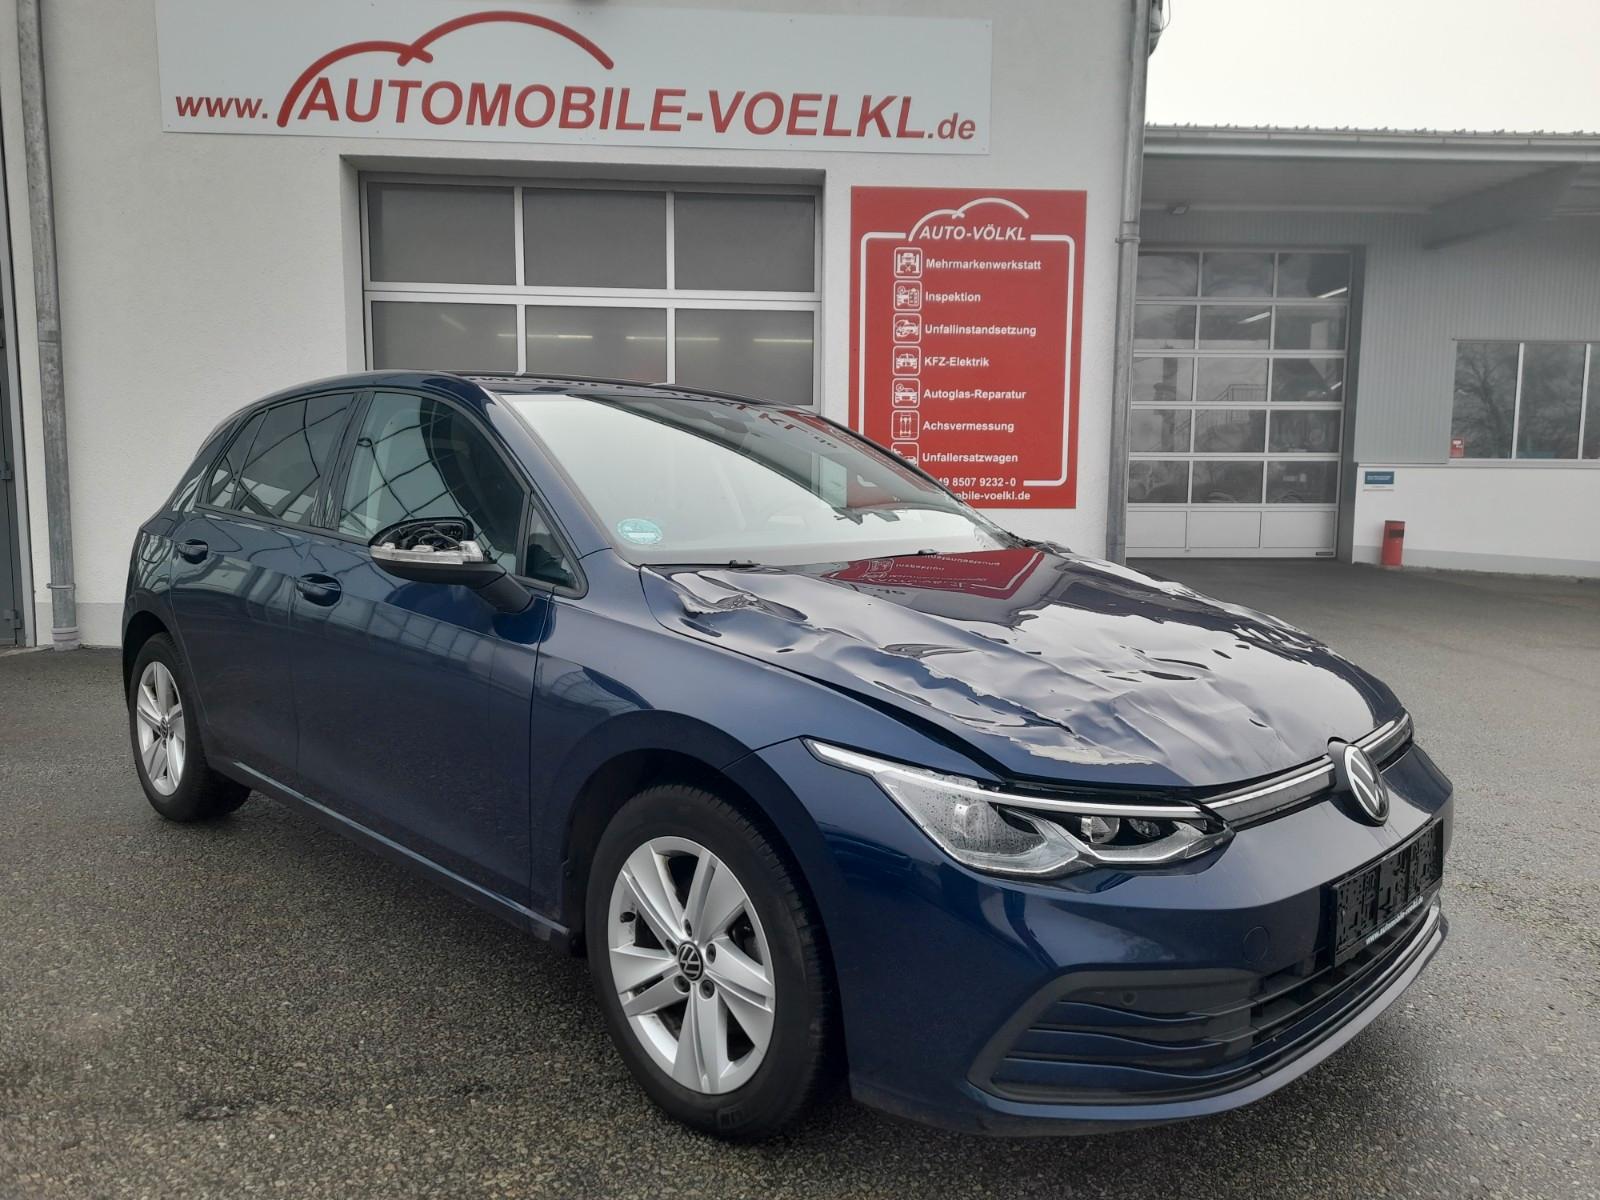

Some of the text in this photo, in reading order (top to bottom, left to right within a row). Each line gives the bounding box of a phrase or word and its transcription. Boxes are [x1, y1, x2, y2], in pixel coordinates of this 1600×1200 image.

[919, 224, 1027, 241] AUTO-VÖLKL
[926, 258, 1042, 271] Mehrmarkenwerkstatt
[925, 292, 981, 303] Inspektion
[925, 324, 1037, 337] Unfallinstandsetzung
[924, 356, 990, 367] KFZ-Elektrik
[923, 389, 1027, 401] Autoglas-Reparatur
[922, 421, 1015, 433] Achsvermessung
[922, 452, 1019, 464] Unfallersatzwagen
[952, 477, 977, 487] 8507
